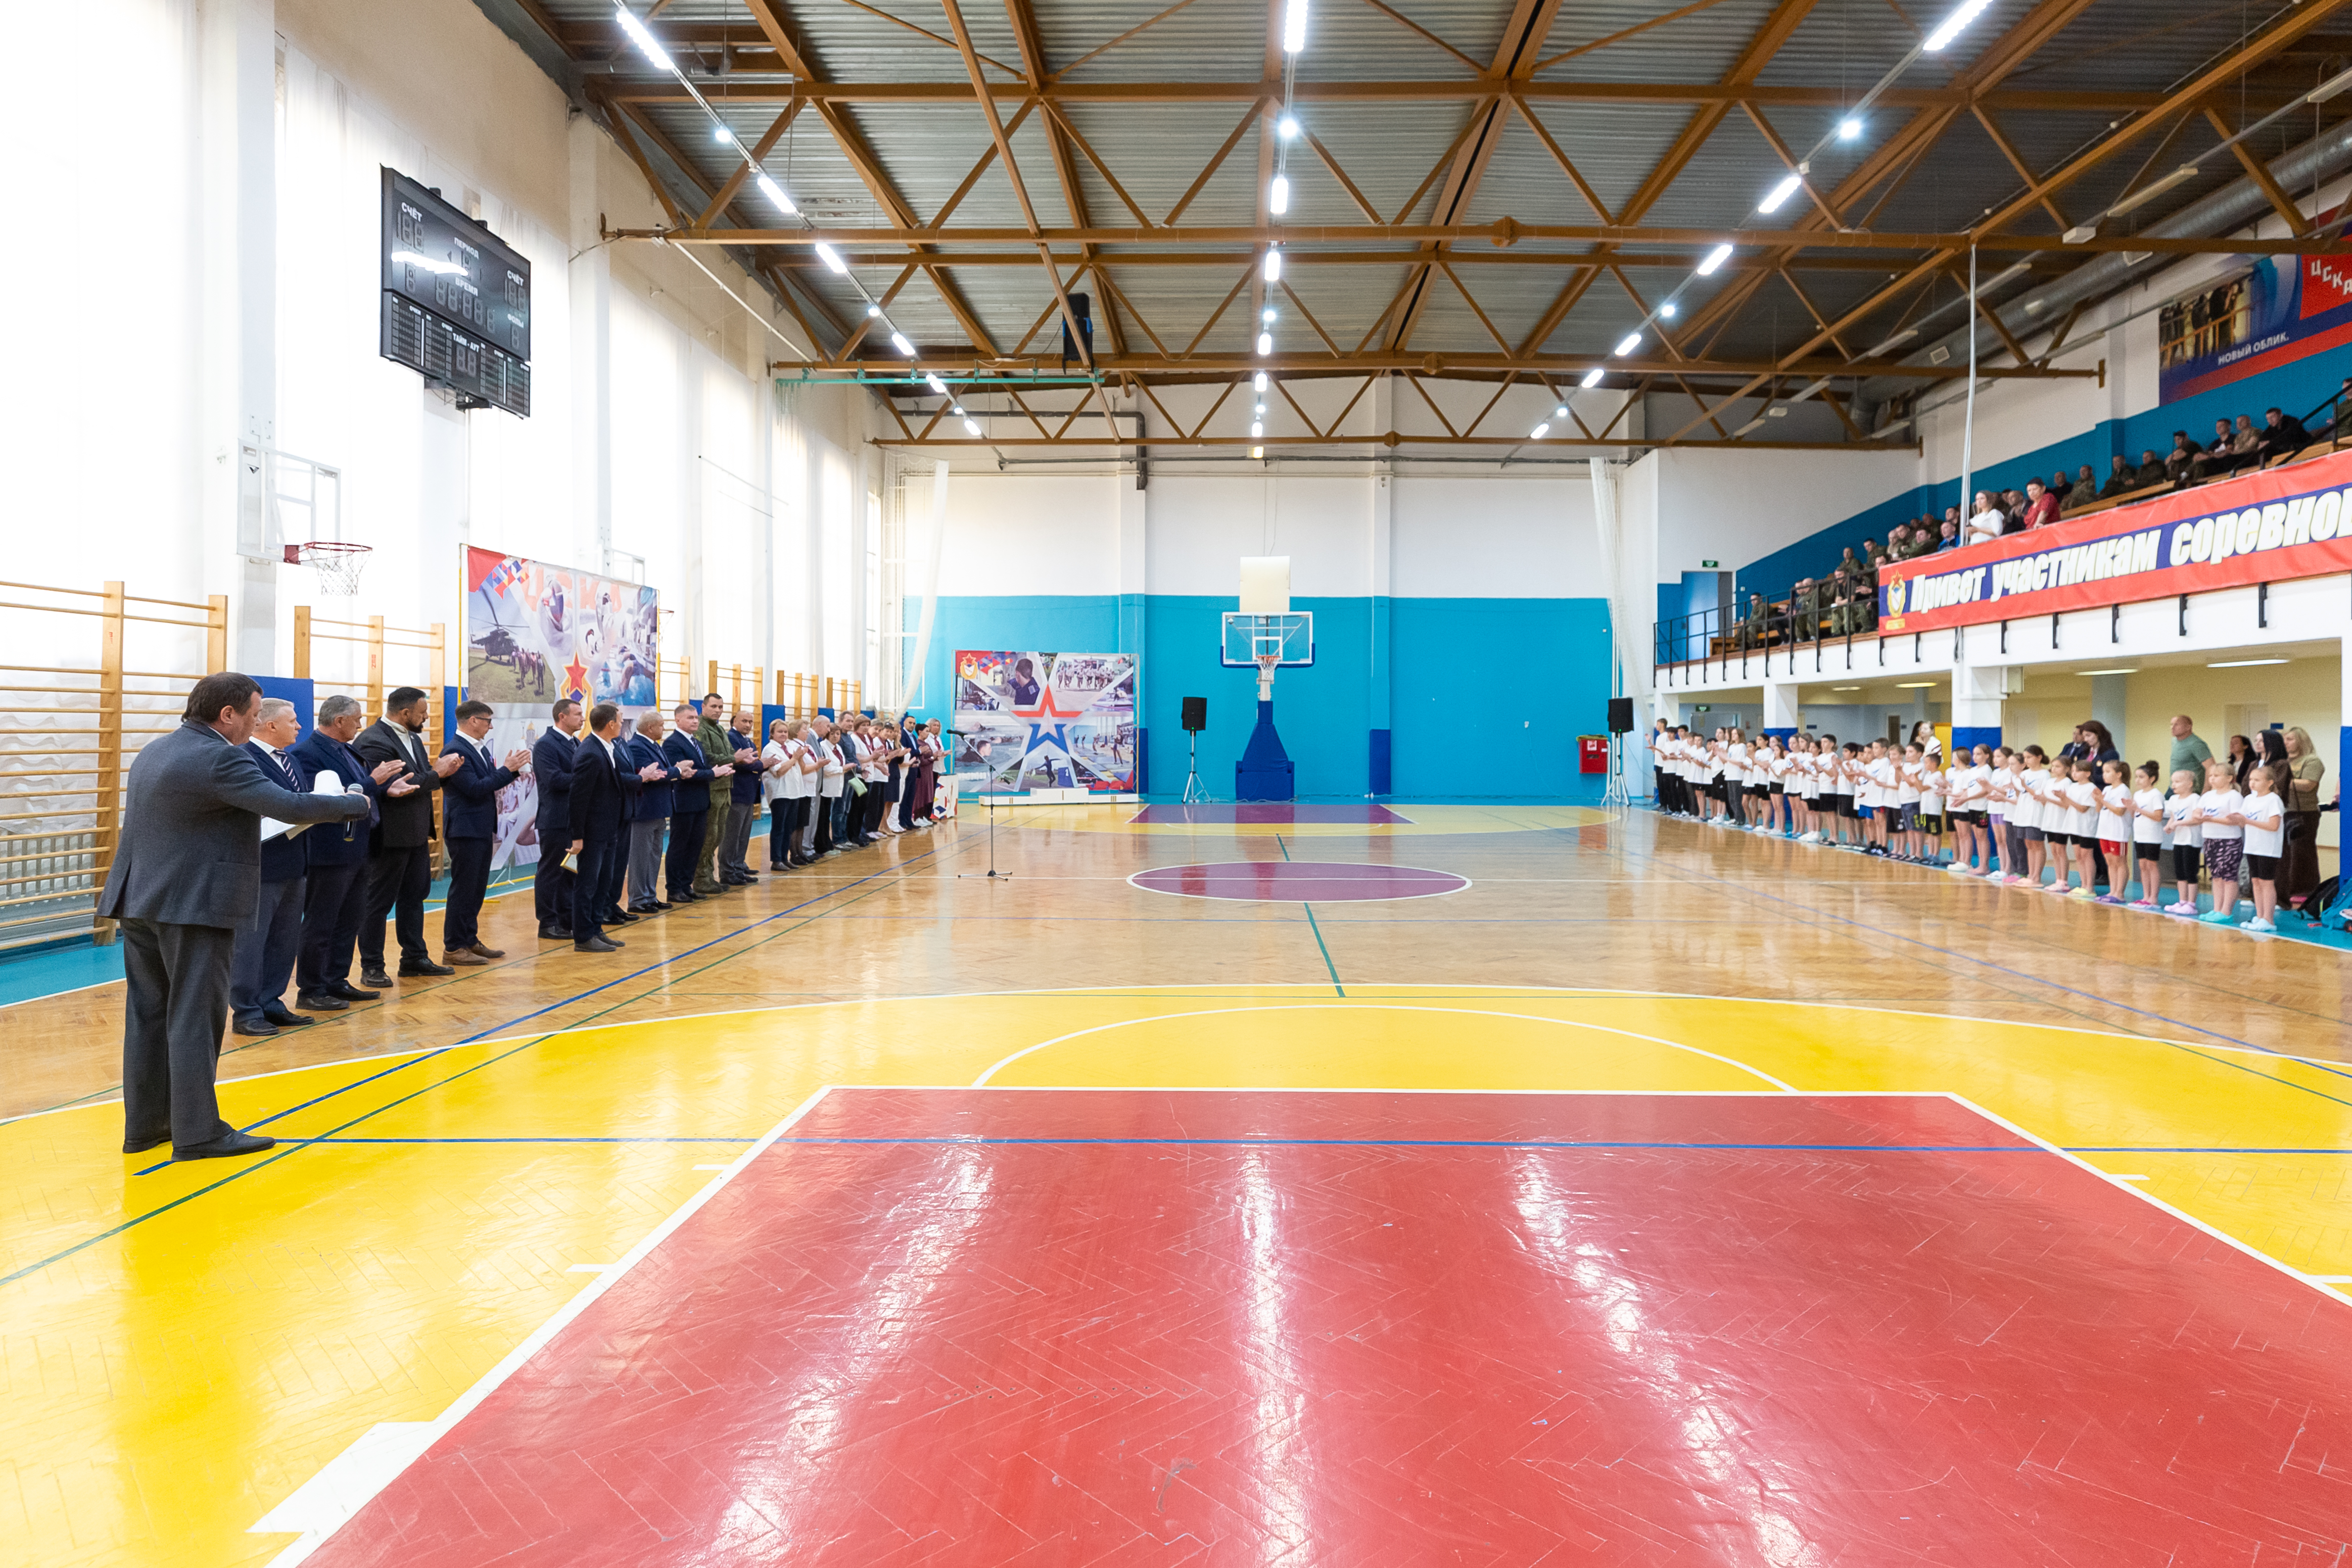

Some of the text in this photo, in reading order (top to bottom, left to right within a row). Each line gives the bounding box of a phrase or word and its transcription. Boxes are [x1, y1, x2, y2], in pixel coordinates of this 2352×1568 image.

[401, 202, 422, 222] СЧЁТ
[454, 237, 479, 260] ПЕРИОД
[455, 277, 478, 297] ВРЕМЯ
[507, 270, 524, 287] СЧЁТ
[2311, 258, 2352, 296] ЦСКА
[507, 313, 524, 328] ФОЛЫ
[2218, 331, 2289, 365] НОВЫЙ ОБЛИК.
[1910, 567, 1987, 614] Привет
[1990, 529, 2161, 602] участникам
